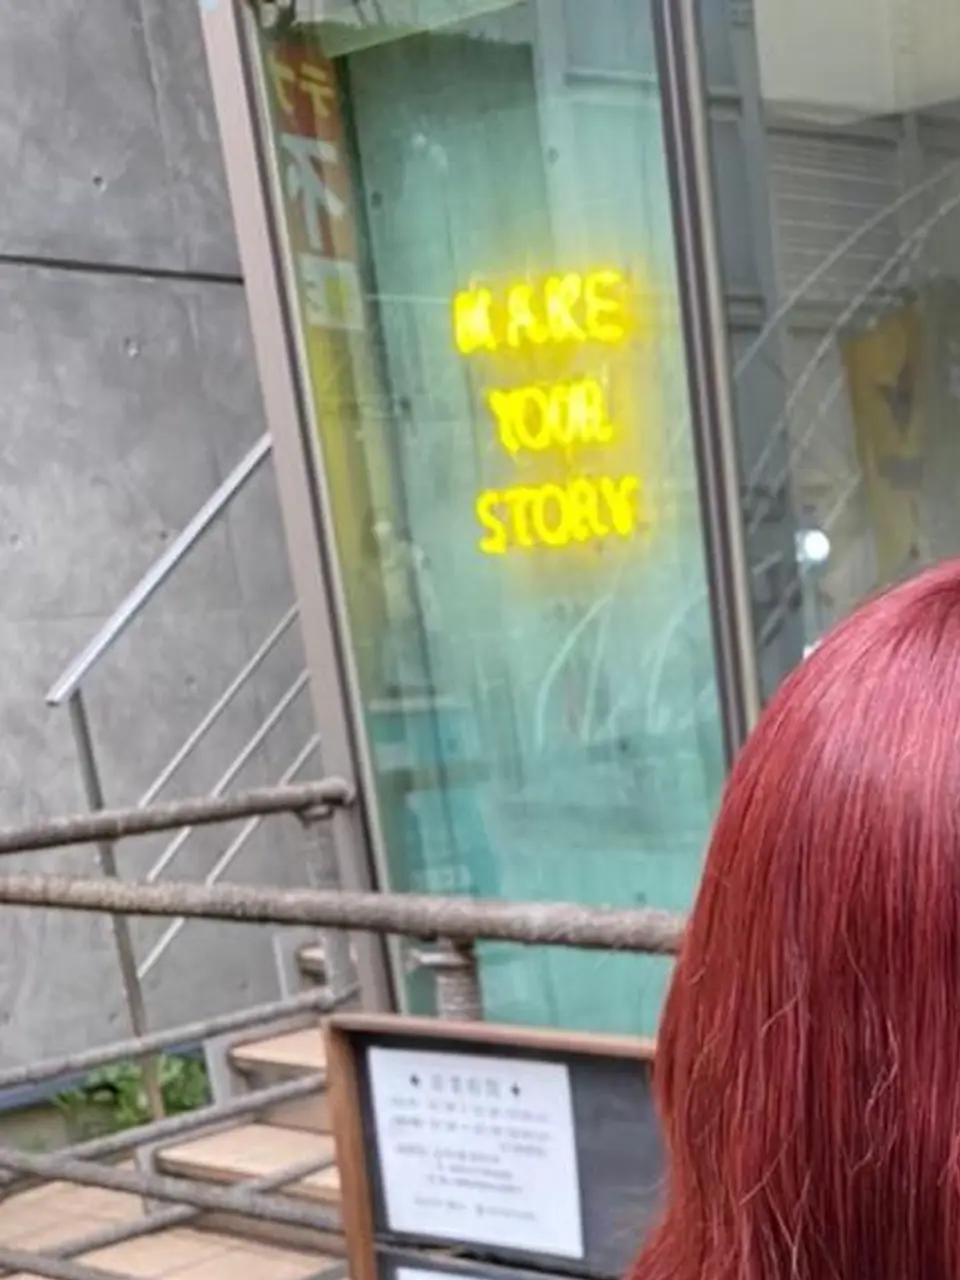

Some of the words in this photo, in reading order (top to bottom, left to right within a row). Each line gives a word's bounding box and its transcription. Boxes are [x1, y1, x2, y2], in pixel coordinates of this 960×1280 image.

[455, 270, 624, 353] MAKE
[489, 380, 614, 452] YOUR
[476, 473, 639, 553] STORY
